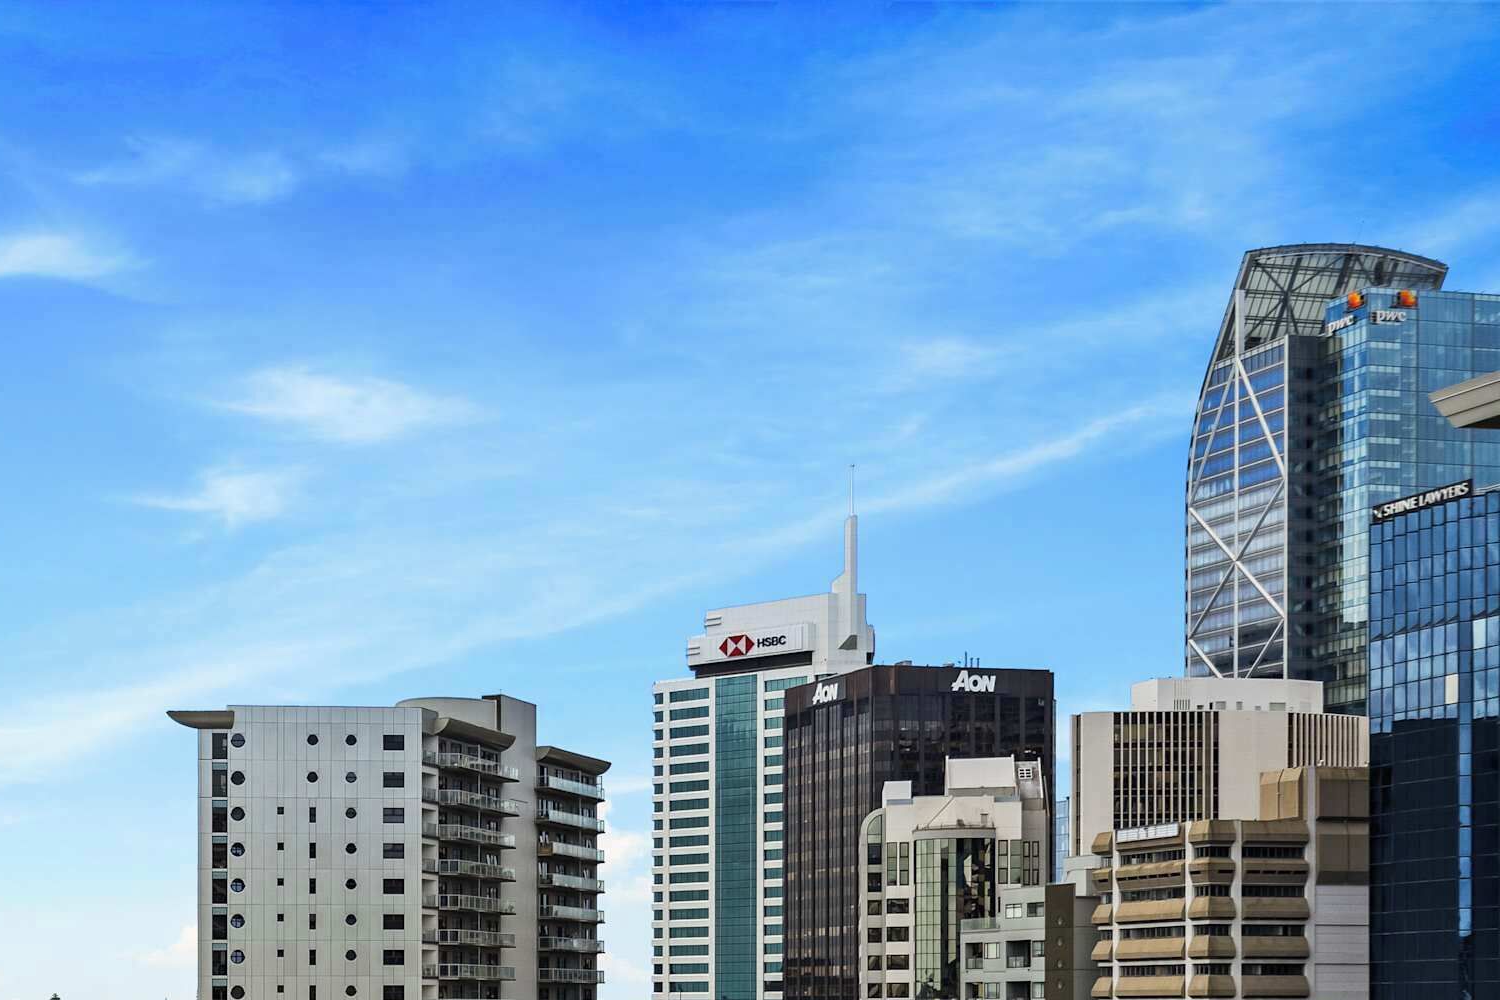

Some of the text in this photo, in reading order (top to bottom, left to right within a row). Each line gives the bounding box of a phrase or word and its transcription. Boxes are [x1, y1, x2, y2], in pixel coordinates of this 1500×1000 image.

[1326, 314, 1354, 337] pwc
[1376, 310, 1406, 324] pwc
[1382, 482, 1469, 516] SHINE LAWYERS
[757, 635, 787, 648] HSBC
